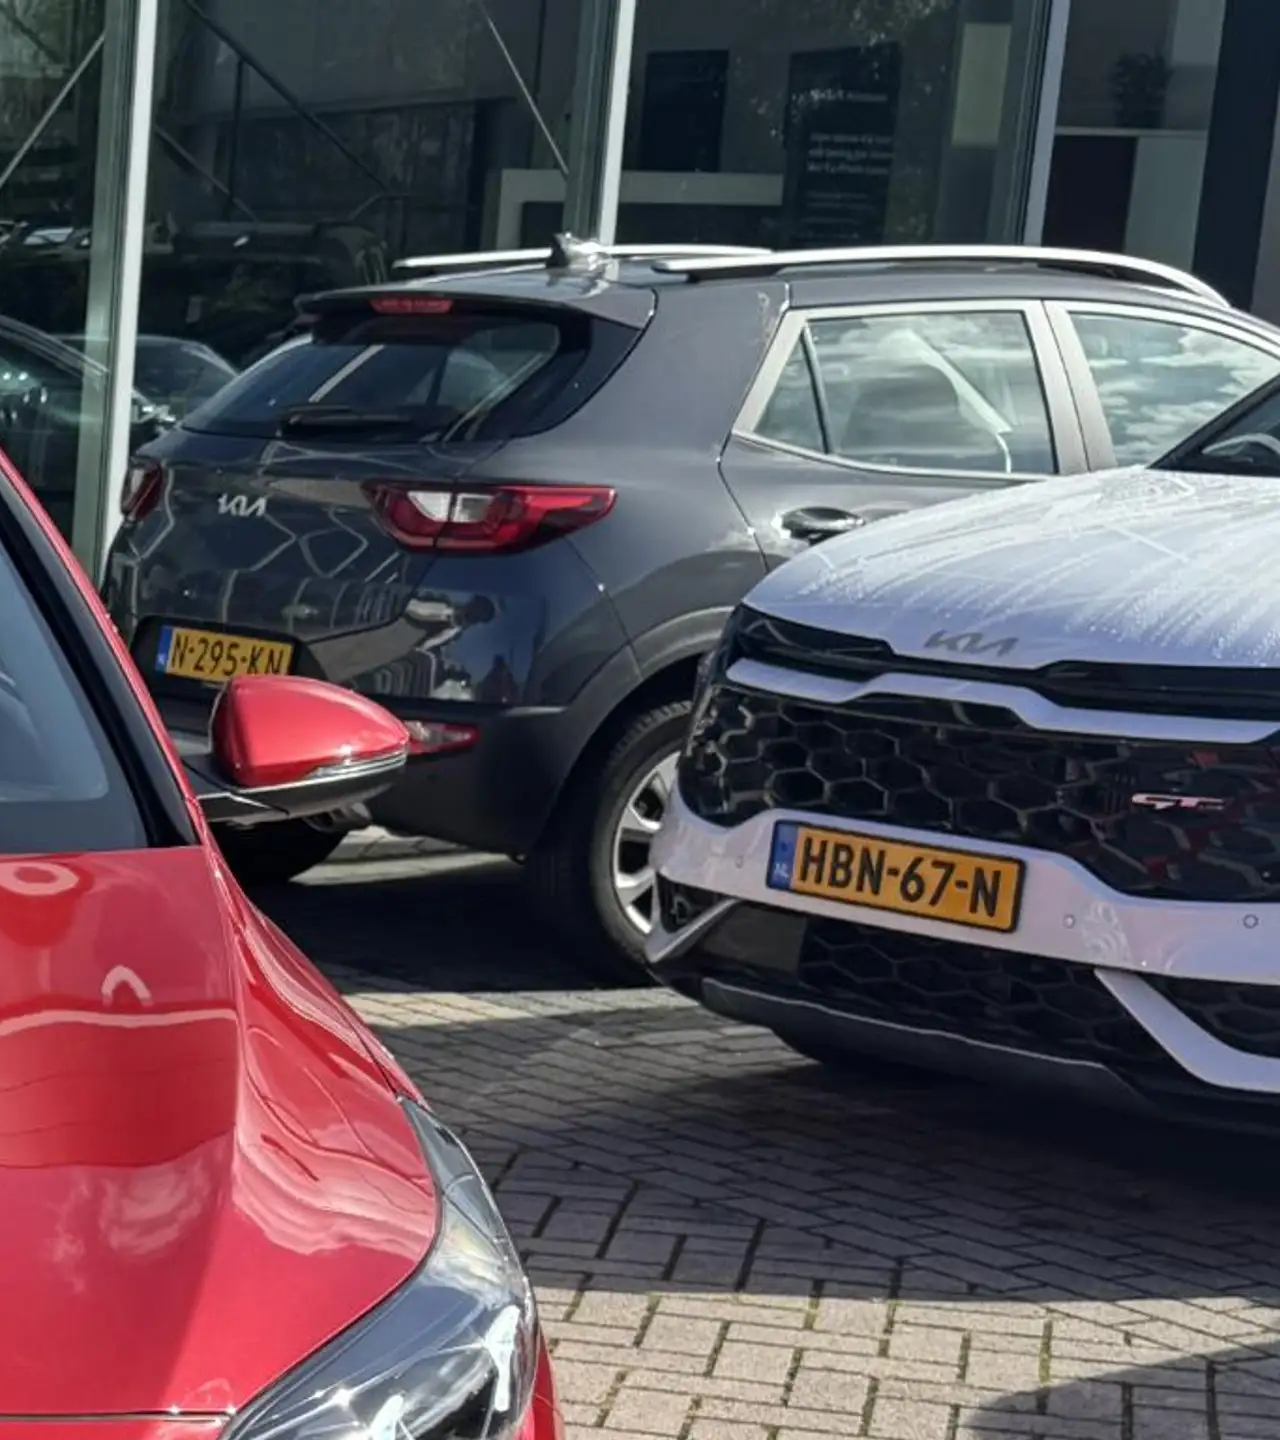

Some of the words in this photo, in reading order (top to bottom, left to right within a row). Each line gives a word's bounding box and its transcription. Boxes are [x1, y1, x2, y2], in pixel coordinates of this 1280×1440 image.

[217, 493, 268, 517] KIA
[171, 632, 285, 676] N-295-KN
[923, 630, 1019, 658] KIA
[799, 836, 1002, 918] HBN-67-N
